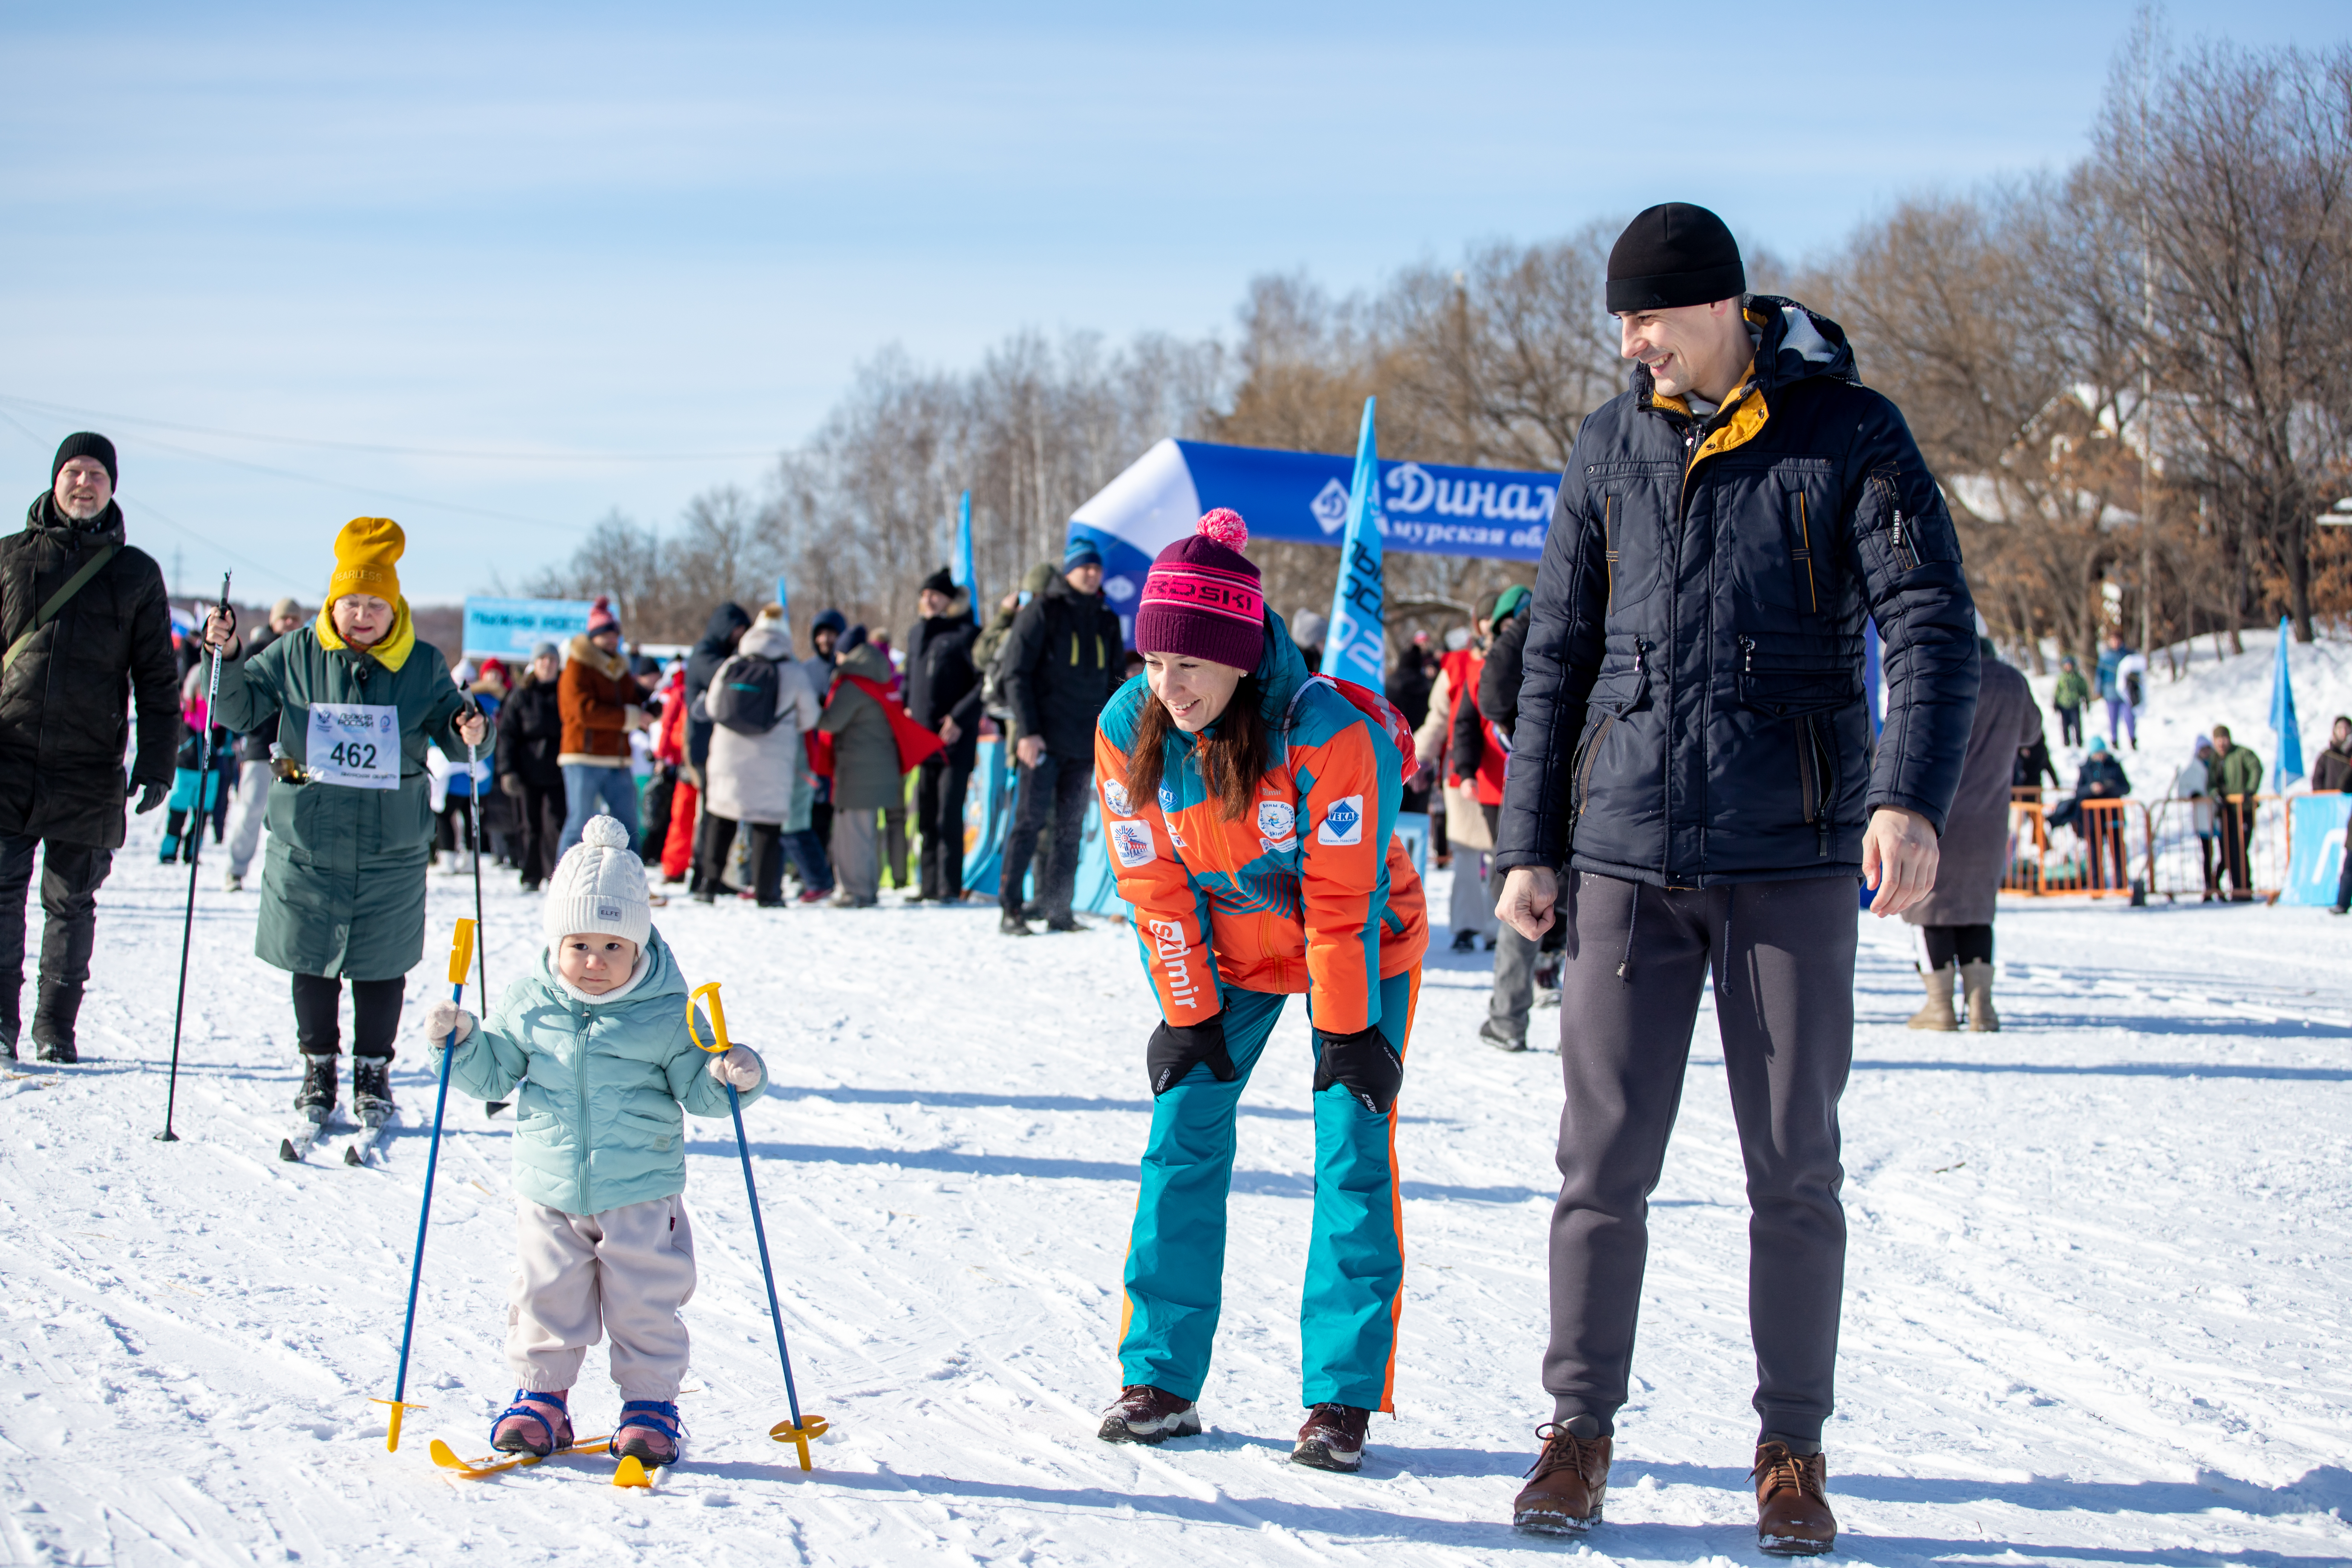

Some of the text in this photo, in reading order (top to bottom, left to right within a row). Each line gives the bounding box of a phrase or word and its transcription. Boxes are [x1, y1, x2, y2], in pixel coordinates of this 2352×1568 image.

[1510, 525, 1545, 549] об
[335, 570, 382, 582] FEARLESS
[338, 719, 374, 727] РОССИИ
[330, 741, 376, 769] 462
[1280, 804, 1294, 824] Богалий
[1330, 812, 1353, 821] VEKA
[1152, 923, 1199, 1009] skimir
